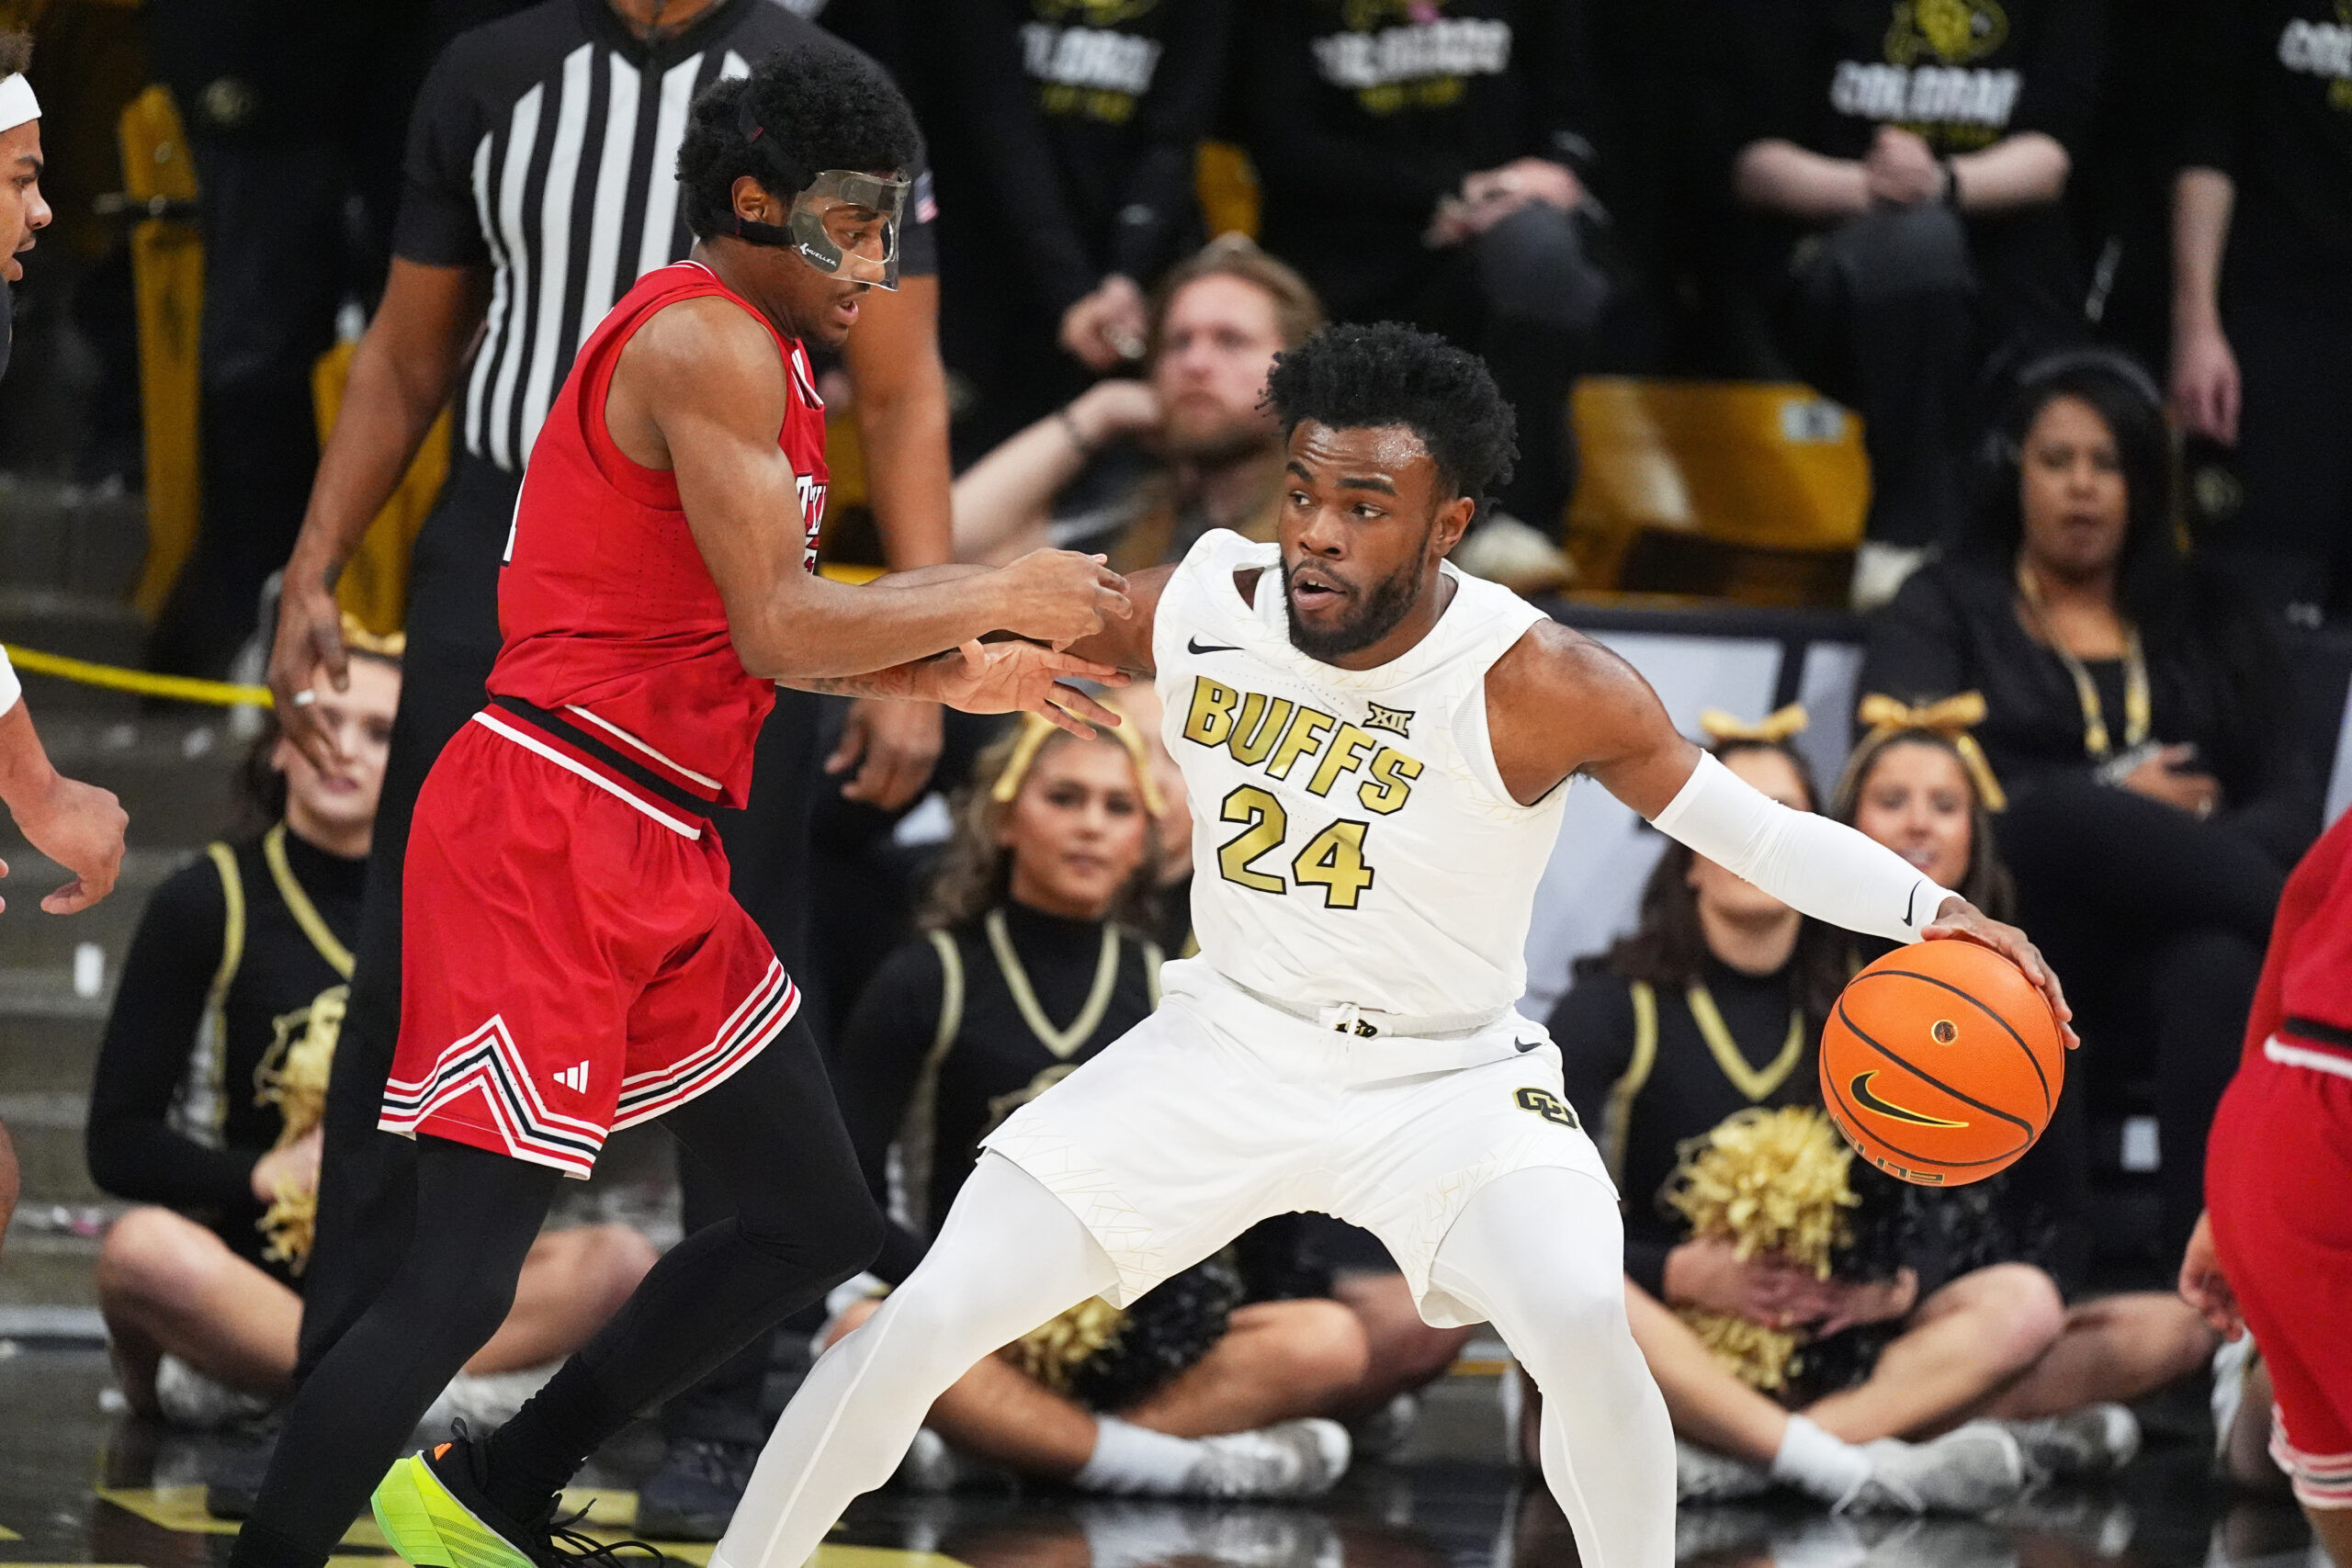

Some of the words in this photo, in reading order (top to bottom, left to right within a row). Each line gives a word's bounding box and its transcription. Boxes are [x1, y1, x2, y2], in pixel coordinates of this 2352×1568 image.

[806, 248, 836, 265] MUELLER
[1182, 675, 1424, 816] BUFFS
[1217, 784, 1374, 909] 24
